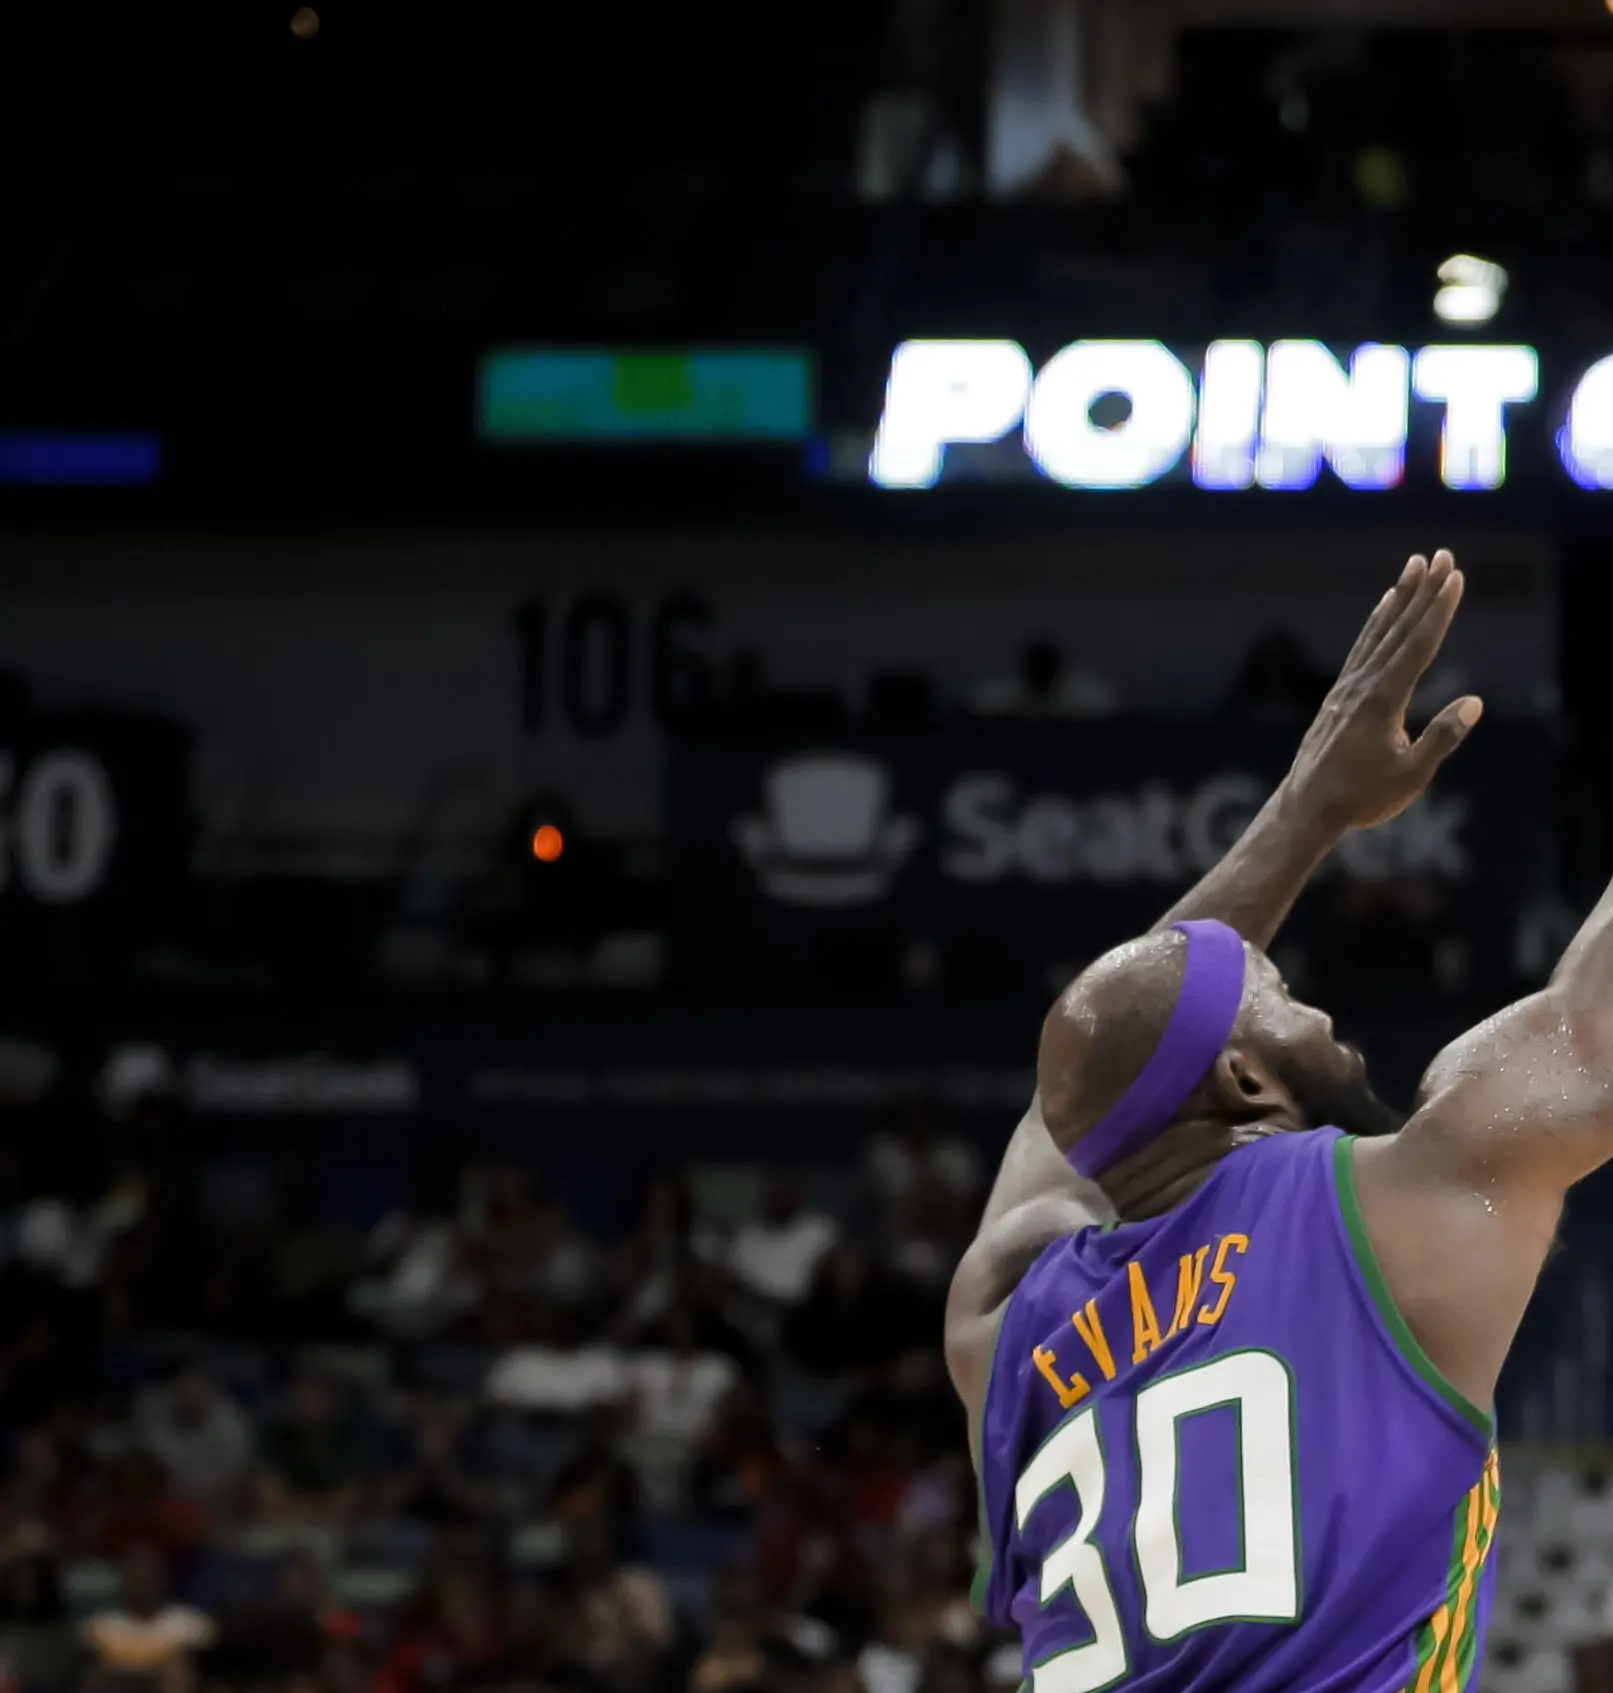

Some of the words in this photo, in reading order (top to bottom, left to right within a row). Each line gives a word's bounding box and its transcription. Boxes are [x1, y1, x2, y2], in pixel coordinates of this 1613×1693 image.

[868, 338, 1540, 490] POINT
[514, 590, 712, 736] 106
[1032, 1233, 1250, 1409] EVANS
